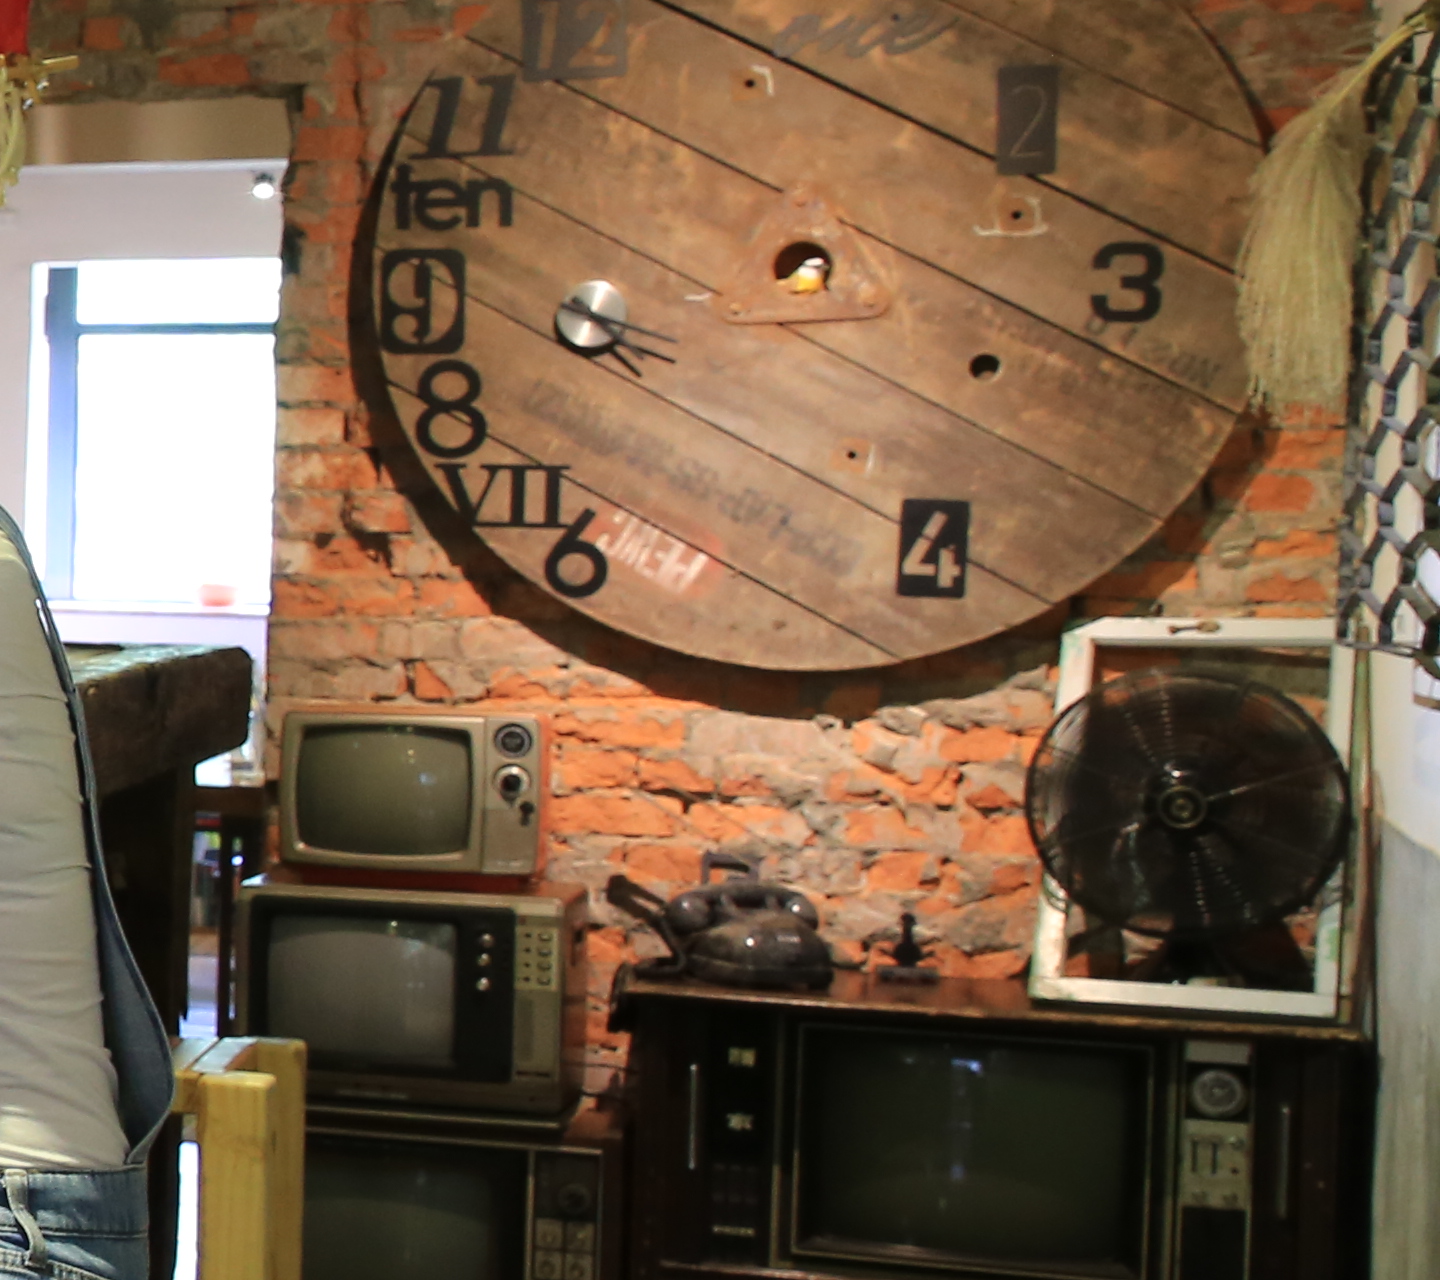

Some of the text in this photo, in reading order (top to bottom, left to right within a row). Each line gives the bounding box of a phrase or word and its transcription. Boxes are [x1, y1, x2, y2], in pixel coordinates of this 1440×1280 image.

[535, 0, 618, 71] 12
[770, 6, 961, 62] one
[409, 73, 518, 161] 11
[1006, 84, 1048, 160] 2
[390, 162, 513, 231] ten
[387, 256, 459, 346] 9
[1090, 240, 1165, 323] 3
[415, 359, 488, 459] 8
[440, 462, 573, 531] VII
[544, 506, 608, 599] 6
[902, 510, 962, 592] 4
